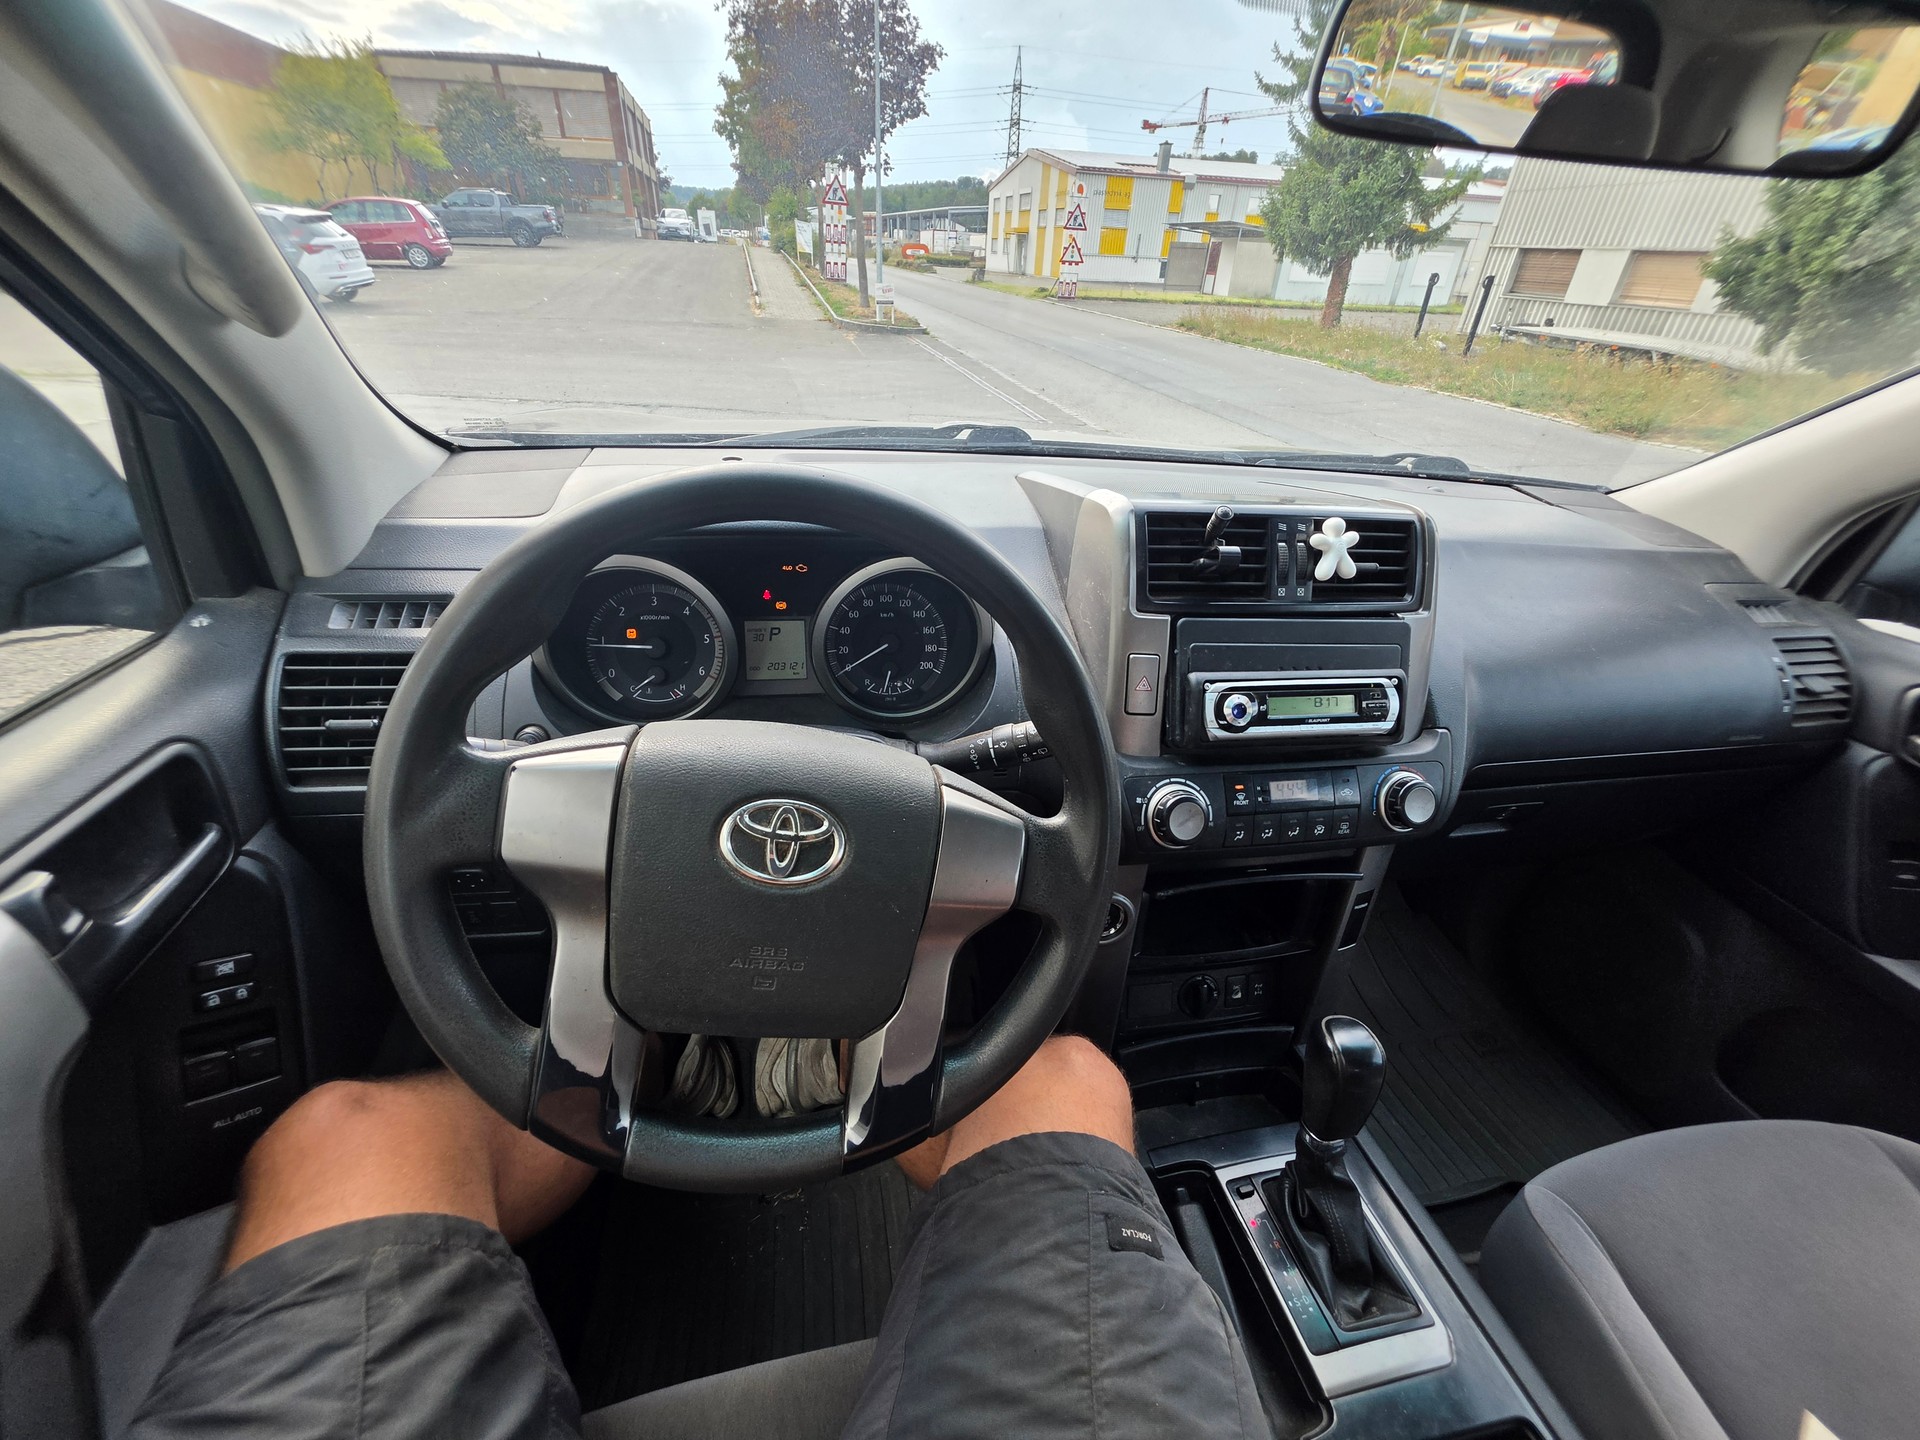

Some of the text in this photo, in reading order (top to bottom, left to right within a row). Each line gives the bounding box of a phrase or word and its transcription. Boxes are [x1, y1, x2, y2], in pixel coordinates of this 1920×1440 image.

[651, 596, 658, 606] 3
[880, 594, 893, 603] 100
[863, 599, 874, 608] 80
[899, 599, 912, 608] 120
[619, 607, 625, 616] 2
[683, 606, 690, 616] 4
[848, 610, 859, 618] 60
[912, 610, 926, 618] 140
[769, 627, 781, 642] P
[839, 626, 850, 635] 40
[922, 626, 935, 635] 160
[704, 633, 710, 644] 5
[753, 633, 765, 642] 30
[838, 646, 849, 654] 20
[924, 644, 938, 653] 180
[920, 661, 934, 670] 200
[608, 668, 616, 678] 0
[698, 666, 705, 676] 6
[1337, 827, 1350, 835] REAR
[749, 946, 788, 956] SRS
[729, 958, 805, 971] AIRBAG
[213, 1106, 262, 1128] ALL AUTO
[1273, 1240, 1281, 1249] R
